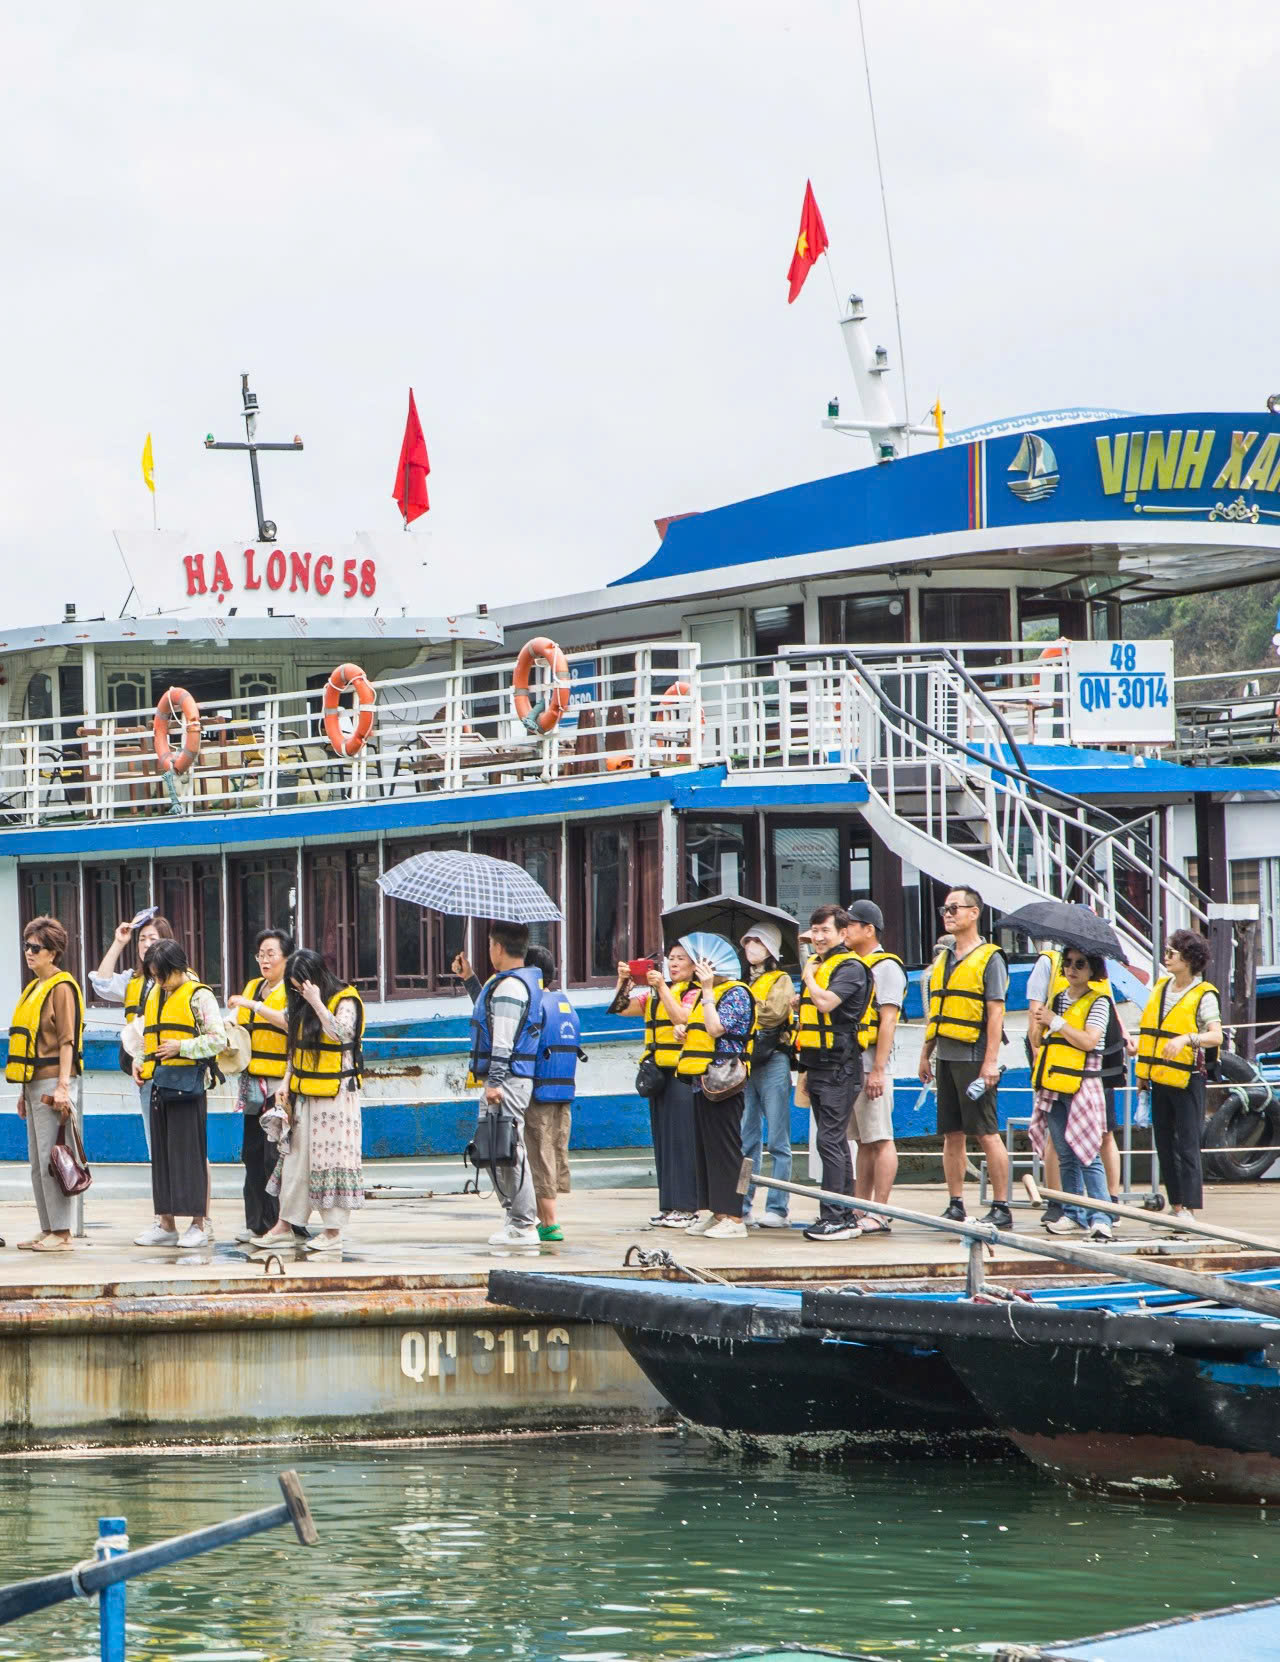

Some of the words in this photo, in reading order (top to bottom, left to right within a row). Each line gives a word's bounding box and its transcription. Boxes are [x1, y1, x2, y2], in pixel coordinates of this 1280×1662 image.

[1095, 429, 1216, 504] VỊNH
[183, 550, 234, 604] HẠ
[243, 548, 335, 596] LONG
[343, 558, 377, 598] 58
[1110, 643, 1136, 672] 48
[1079, 677, 1169, 713] QN-3014
[400, 1330, 457, 1383] QN
